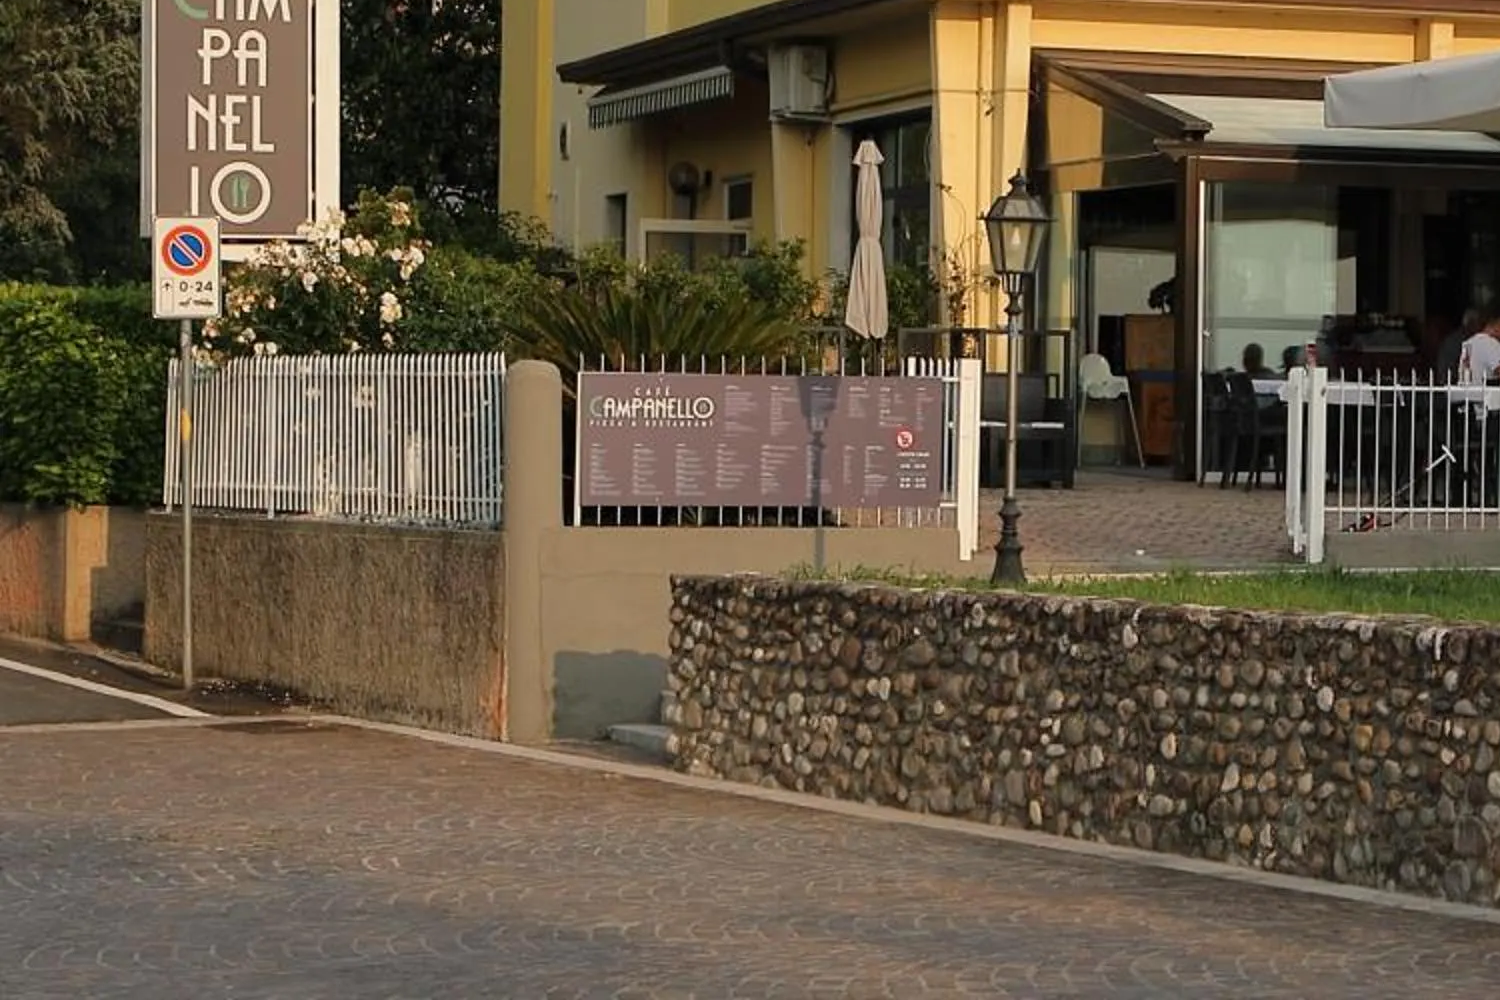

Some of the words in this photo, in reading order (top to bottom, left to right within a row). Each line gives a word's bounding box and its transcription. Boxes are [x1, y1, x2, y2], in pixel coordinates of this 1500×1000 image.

[198, 28, 267, 87] PA
[187, 94, 275, 153] NEL
[590, 396, 715, 419] CAMPANELLO
